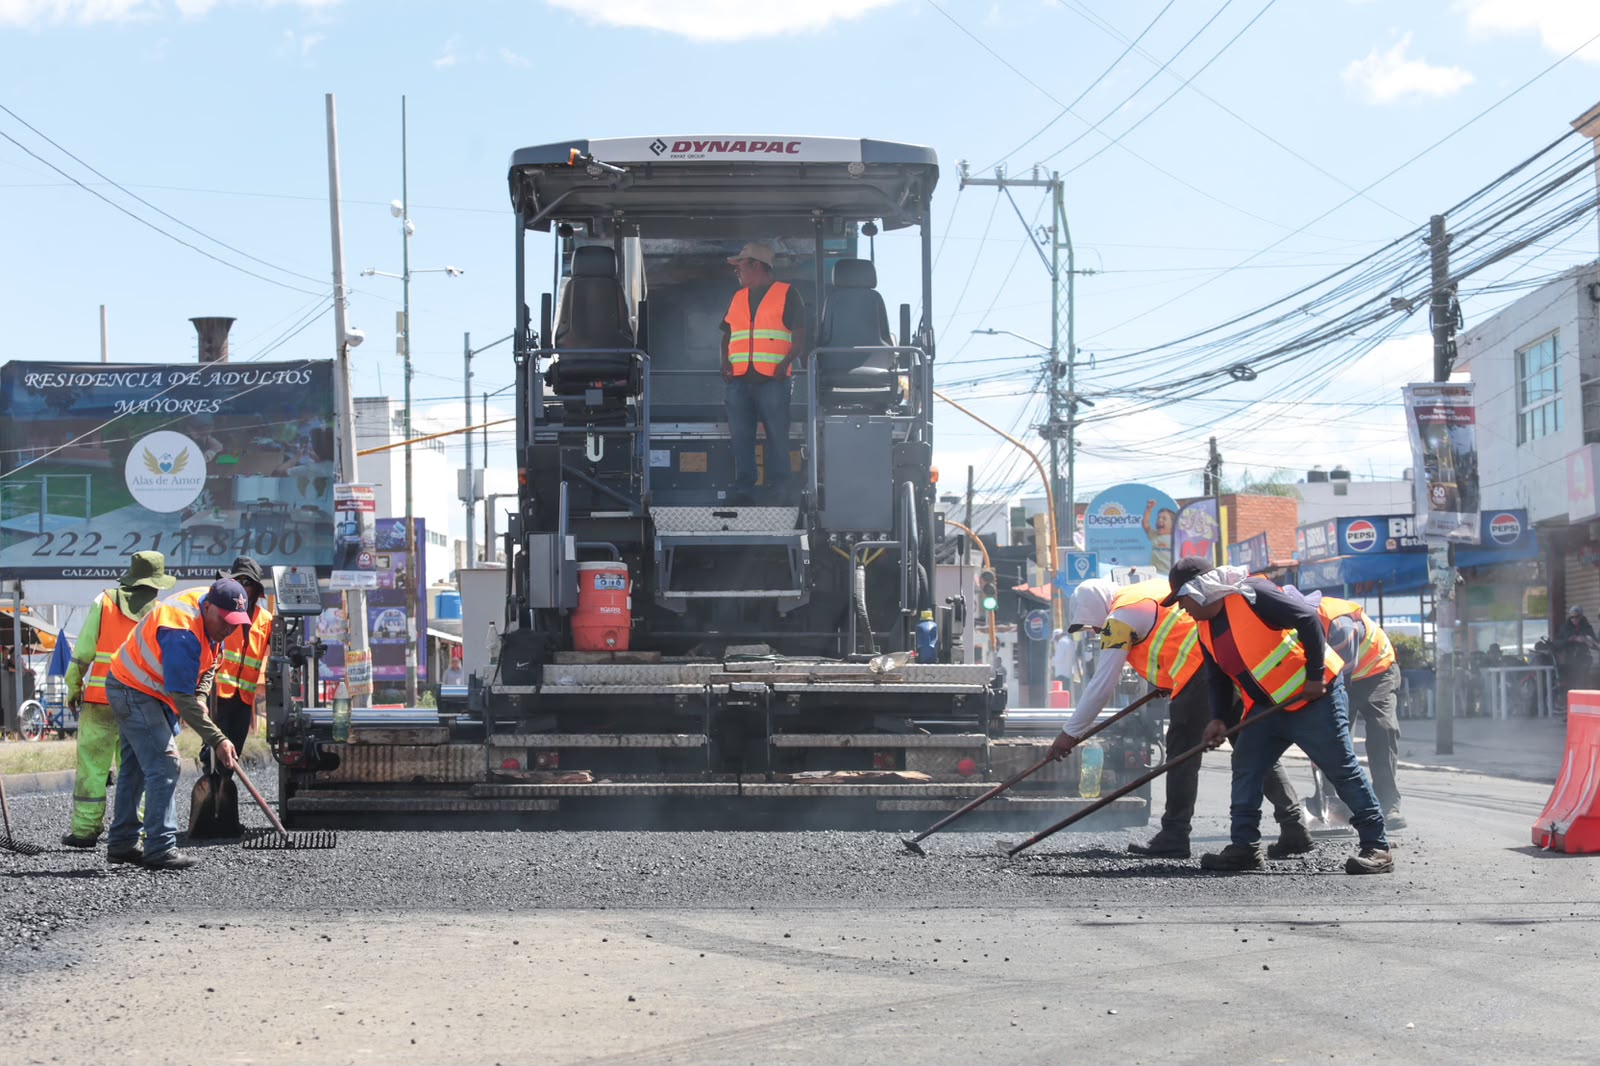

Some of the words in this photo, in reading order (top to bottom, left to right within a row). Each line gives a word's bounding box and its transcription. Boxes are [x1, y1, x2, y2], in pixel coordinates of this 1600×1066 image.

[671, 141, 801, 154] DYNAPAC
[24, 372, 162, 388] RESIDENCIA
[168, 371, 202, 386] DE
[204, 369, 312, 387] ADULTOS
[113, 398, 222, 415] MAYORES
[132, 476, 154, 486] Alas
[156, 475, 168, 486] de
[171, 476, 202, 486] Amor
[1433, 488, 1445, 497] 60
[1089, 515, 1142, 527] Despertar
[32, 531, 301, 557] 222-217-8400
[62, 569, 117, 577] CALZADA
[187, 568, 232, 577] PUEBA
